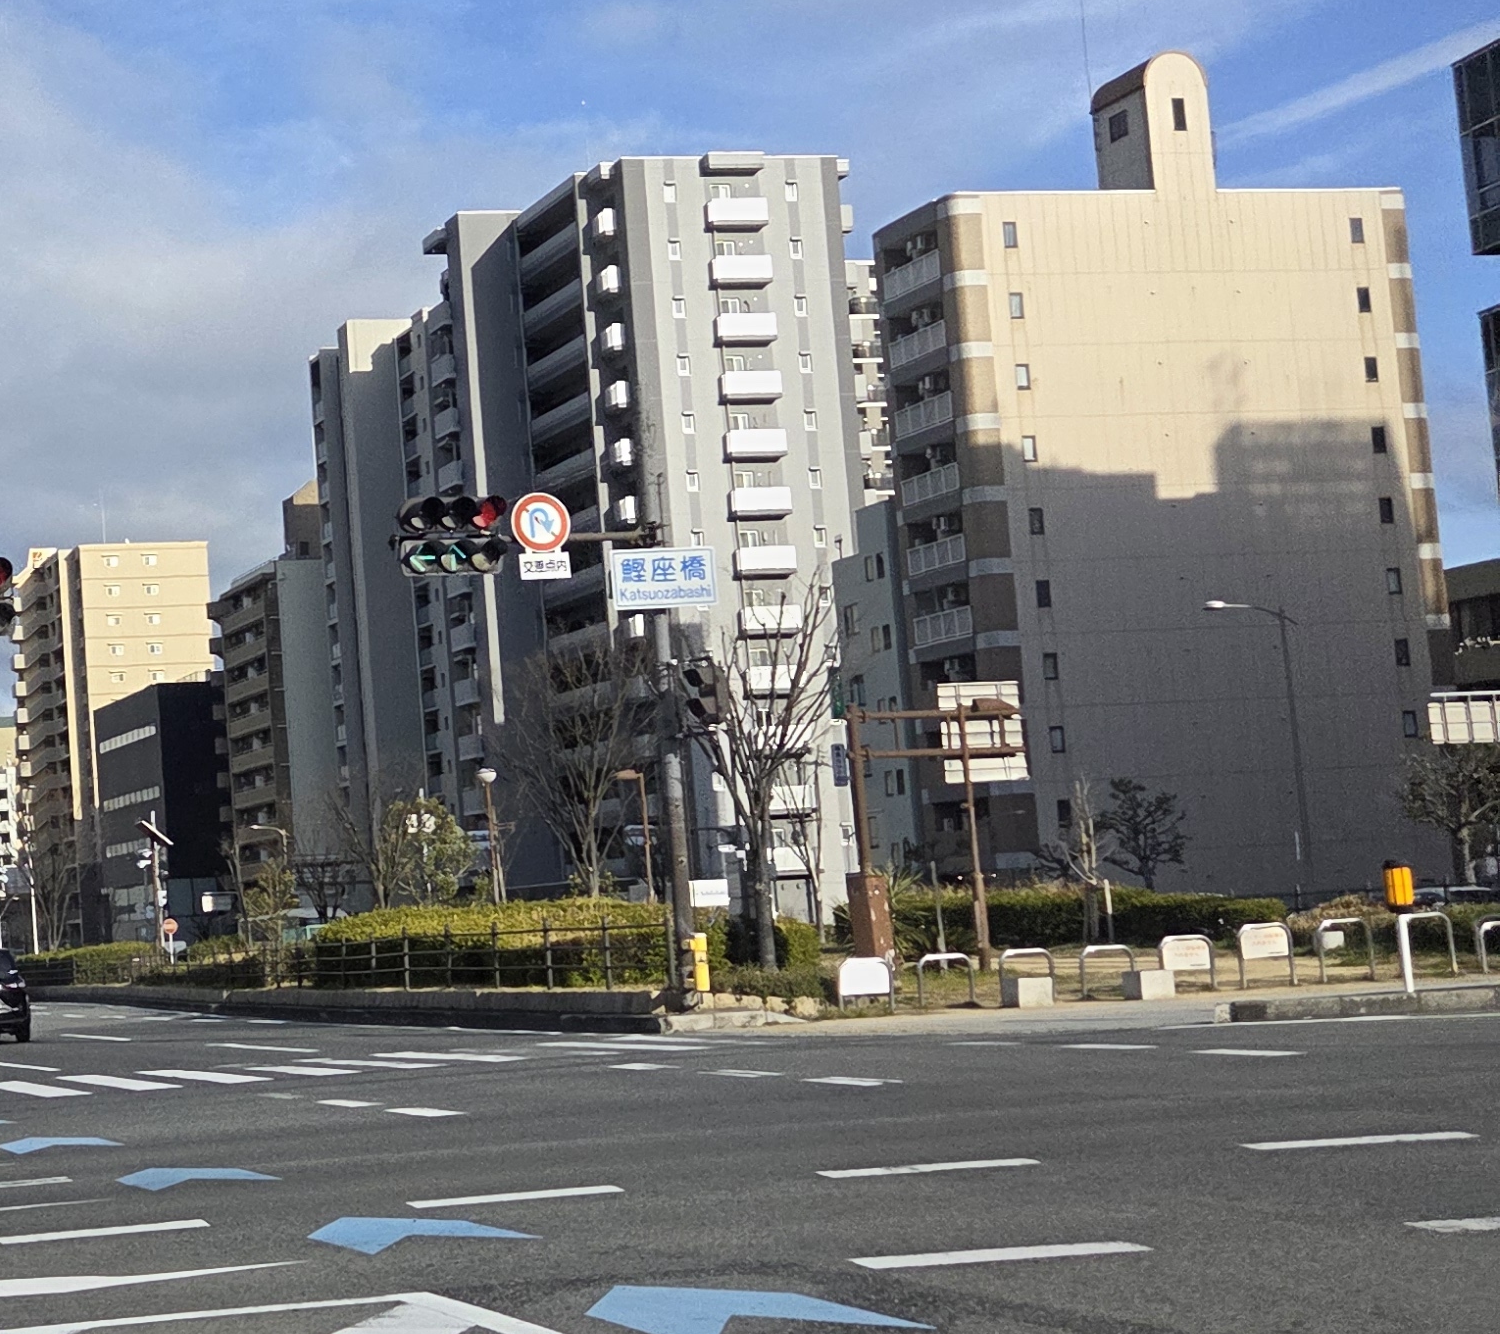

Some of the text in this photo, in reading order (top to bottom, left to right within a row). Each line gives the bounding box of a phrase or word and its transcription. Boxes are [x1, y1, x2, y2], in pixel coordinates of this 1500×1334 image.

[620, 554, 707, 583] 鰹座橋
[619, 584, 712, 602] Katsuozabashi
